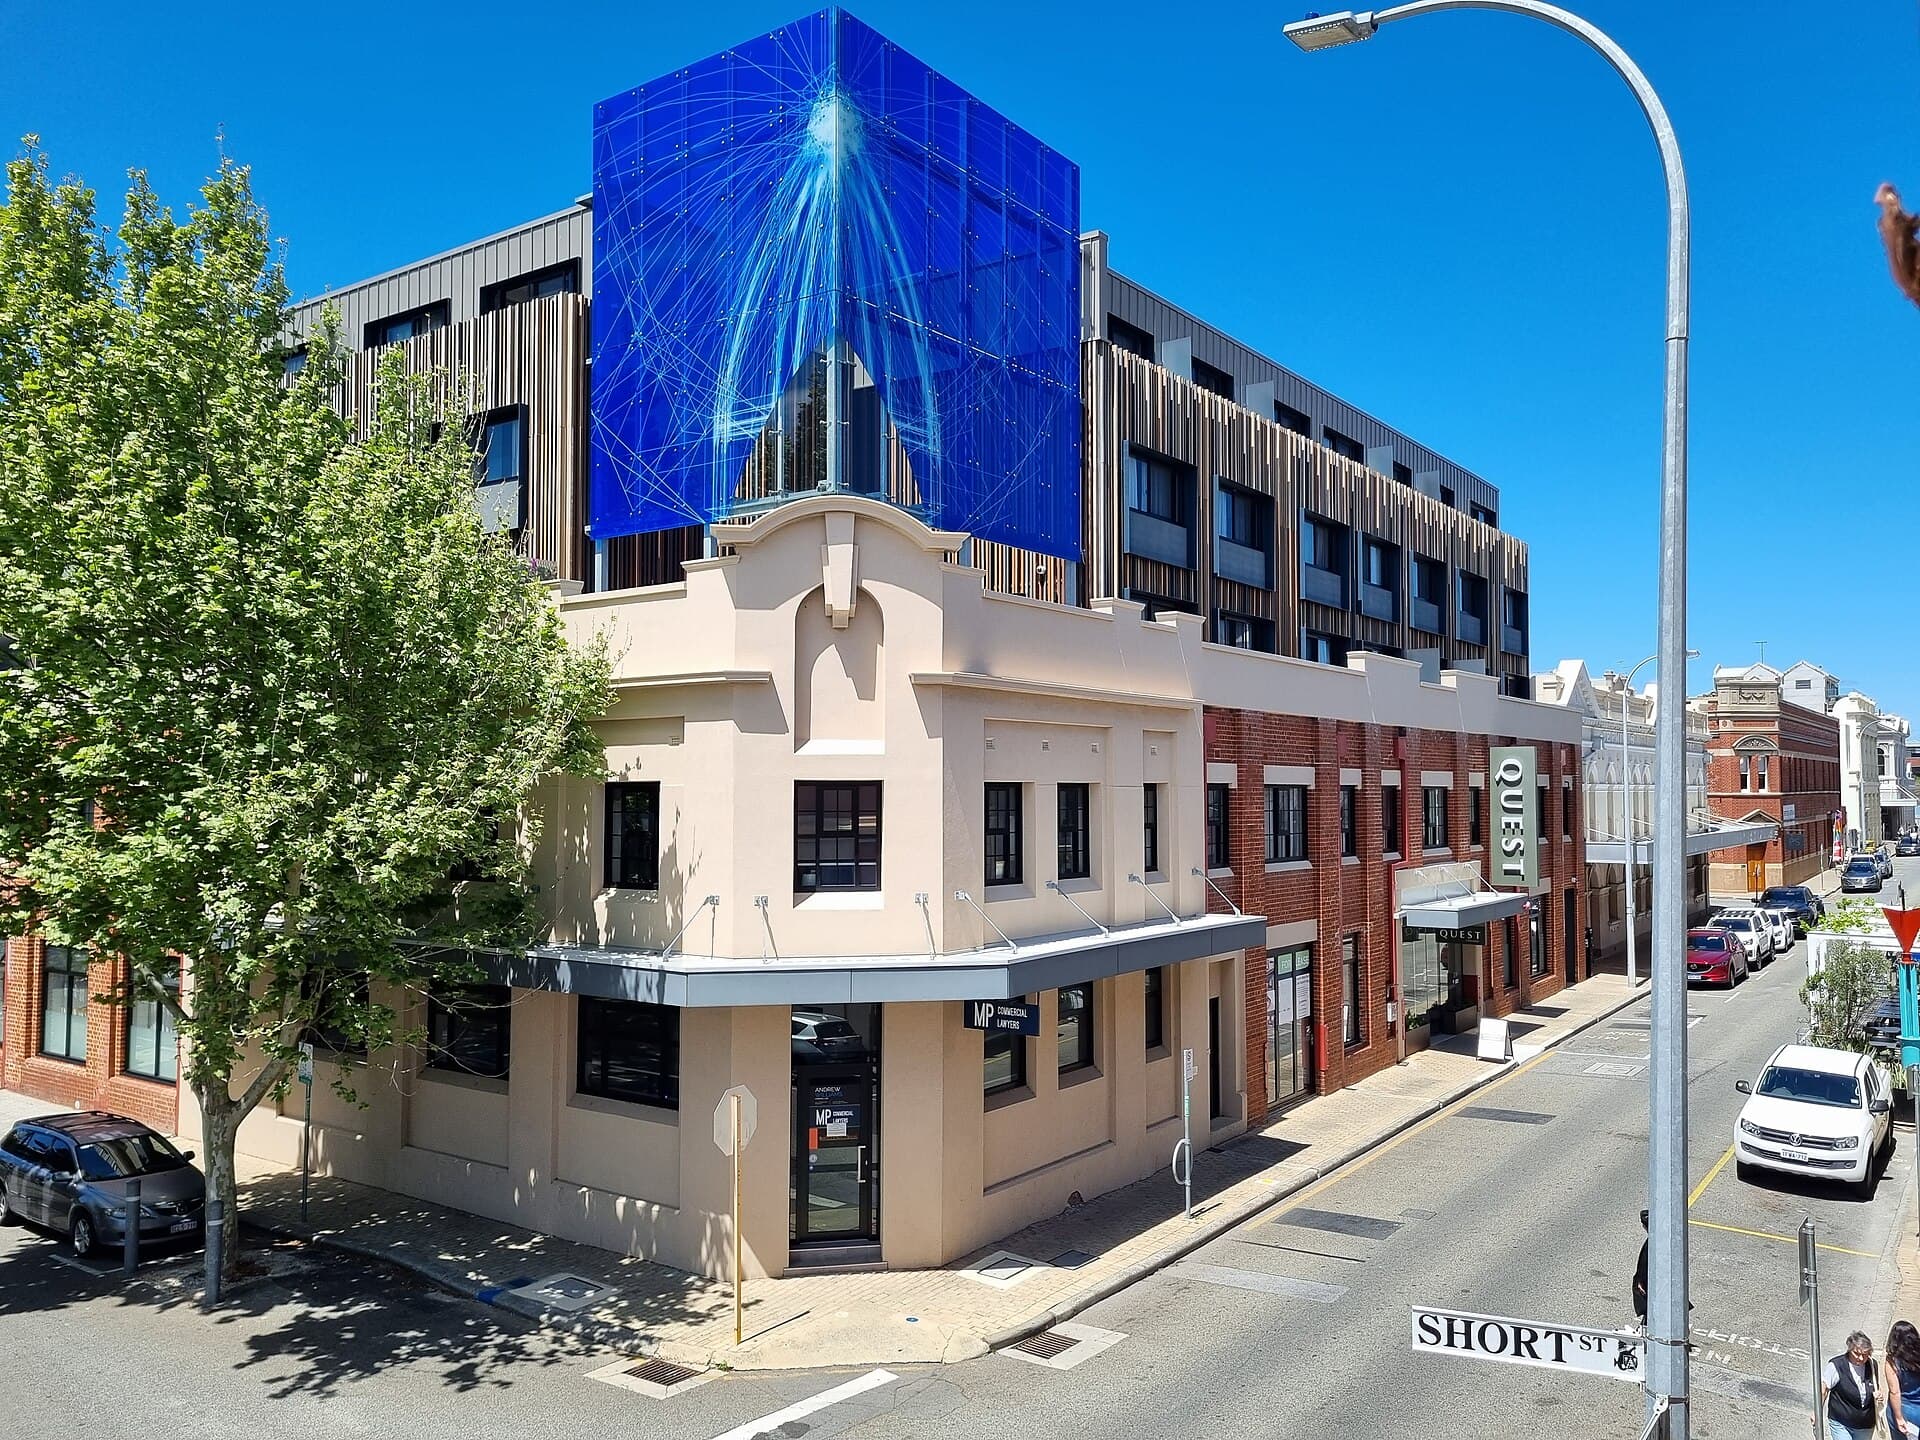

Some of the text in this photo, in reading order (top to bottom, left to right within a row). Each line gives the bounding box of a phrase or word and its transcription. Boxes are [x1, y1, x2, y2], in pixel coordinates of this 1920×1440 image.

[1495, 758, 1525, 881] QUEST
[1440, 928, 1481, 940] QUEST
[974, 1001, 995, 1028] MP
[997, 1006, 1028, 1018] COMMERCIAL
[997, 1018, 1020, 1030] LAWYERS
[815, 1108, 832, 1126] MP
[1418, 1314, 1607, 1364] SHORT ST
